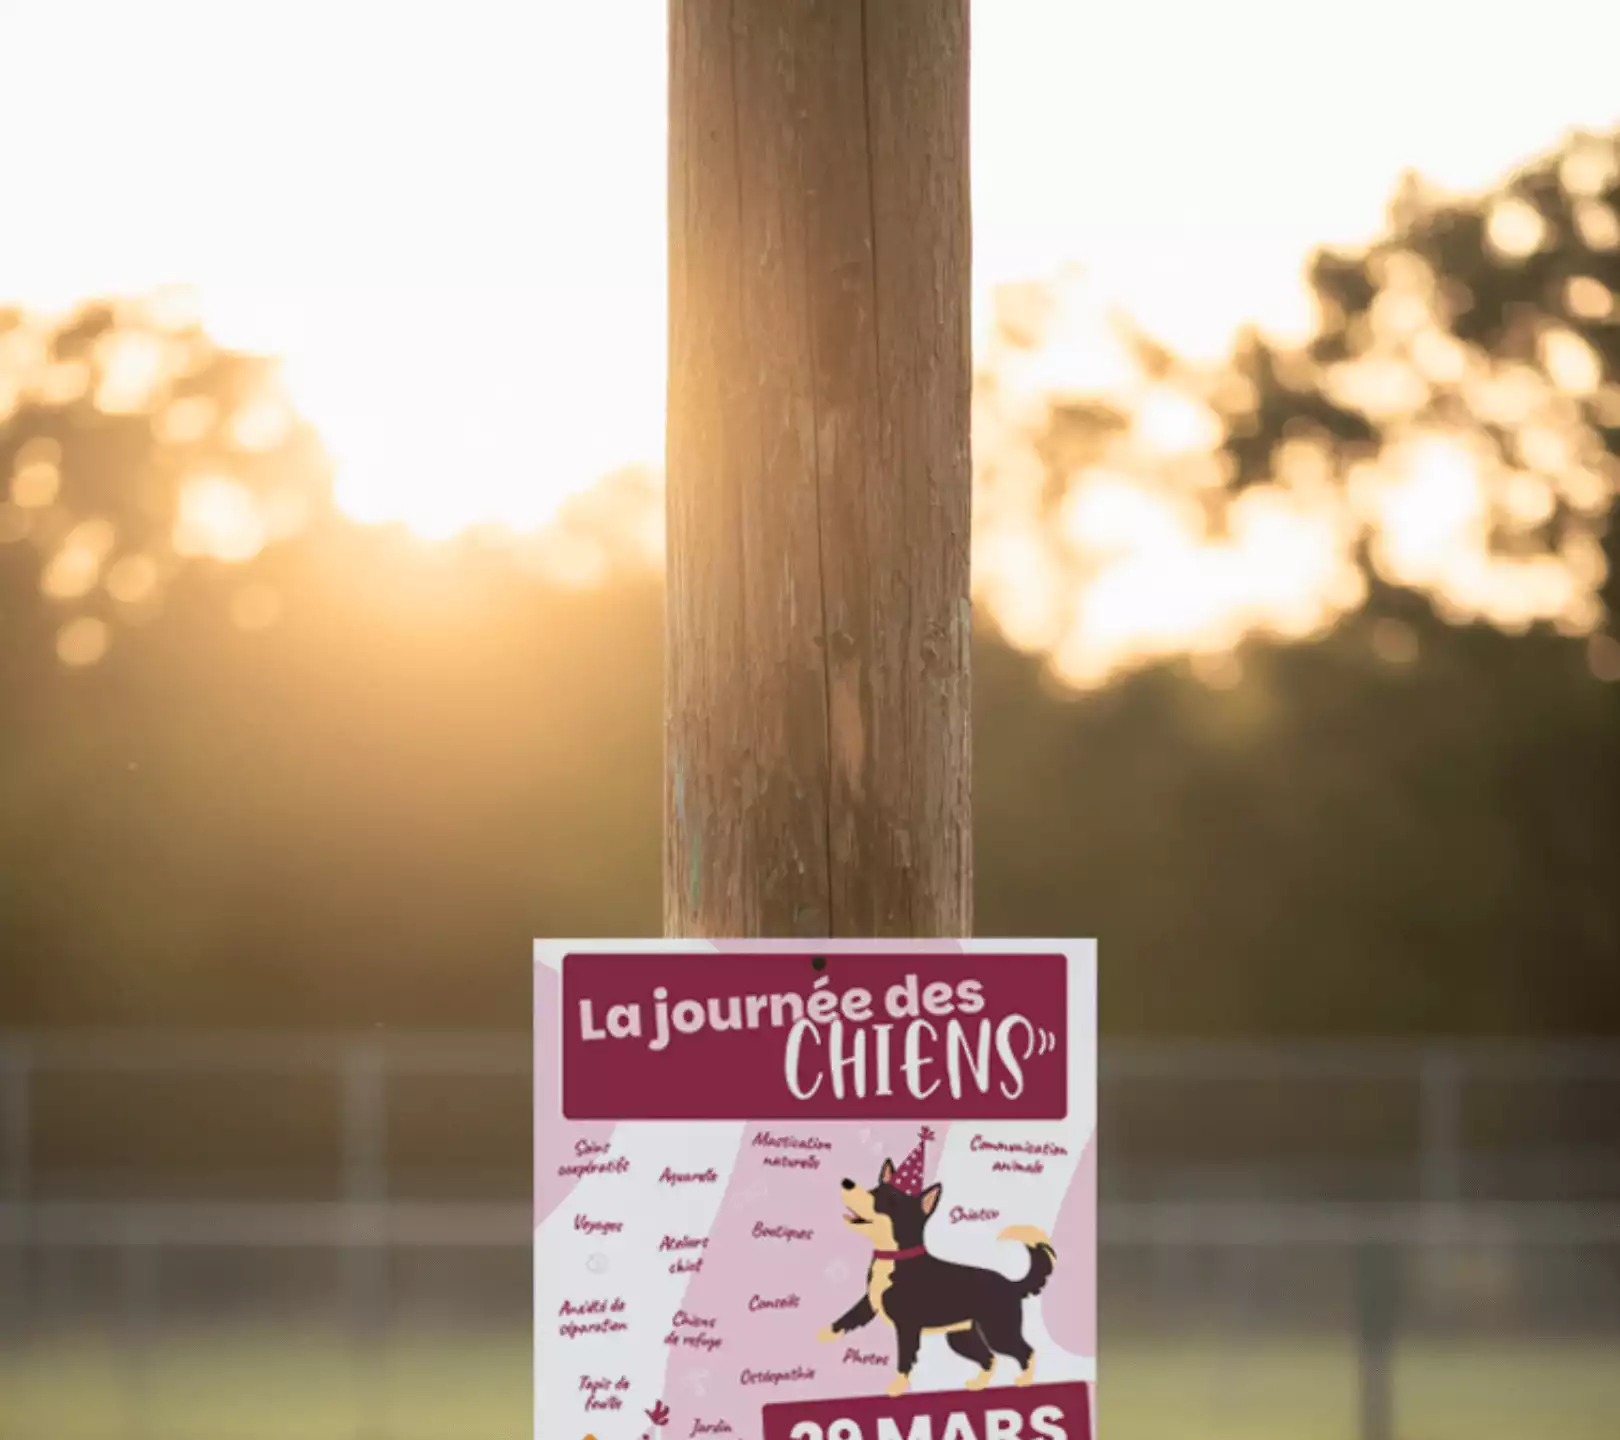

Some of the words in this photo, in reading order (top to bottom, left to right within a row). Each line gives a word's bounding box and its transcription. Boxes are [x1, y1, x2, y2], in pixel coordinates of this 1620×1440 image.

[580, 1000, 641, 1040] La
[649, 976, 874, 1050] journée
[885, 974, 985, 1018] des
[784, 1014, 1034, 1100] CHIENS
[752, 1132, 832, 1150] Mastication
[970, 1134, 1067, 1156] Communication
[574, 1214, 623, 1235] Voyages
[752, 1221, 814, 1242] Boutiques
[748, 1294, 800, 1312] Conseils
[664, 1330, 680, 1347] de
[683, 1332, 722, 1352] refuge
[843, 1348, 889, 1366] Photos
[690, 1418, 732, 1438] Jardin
